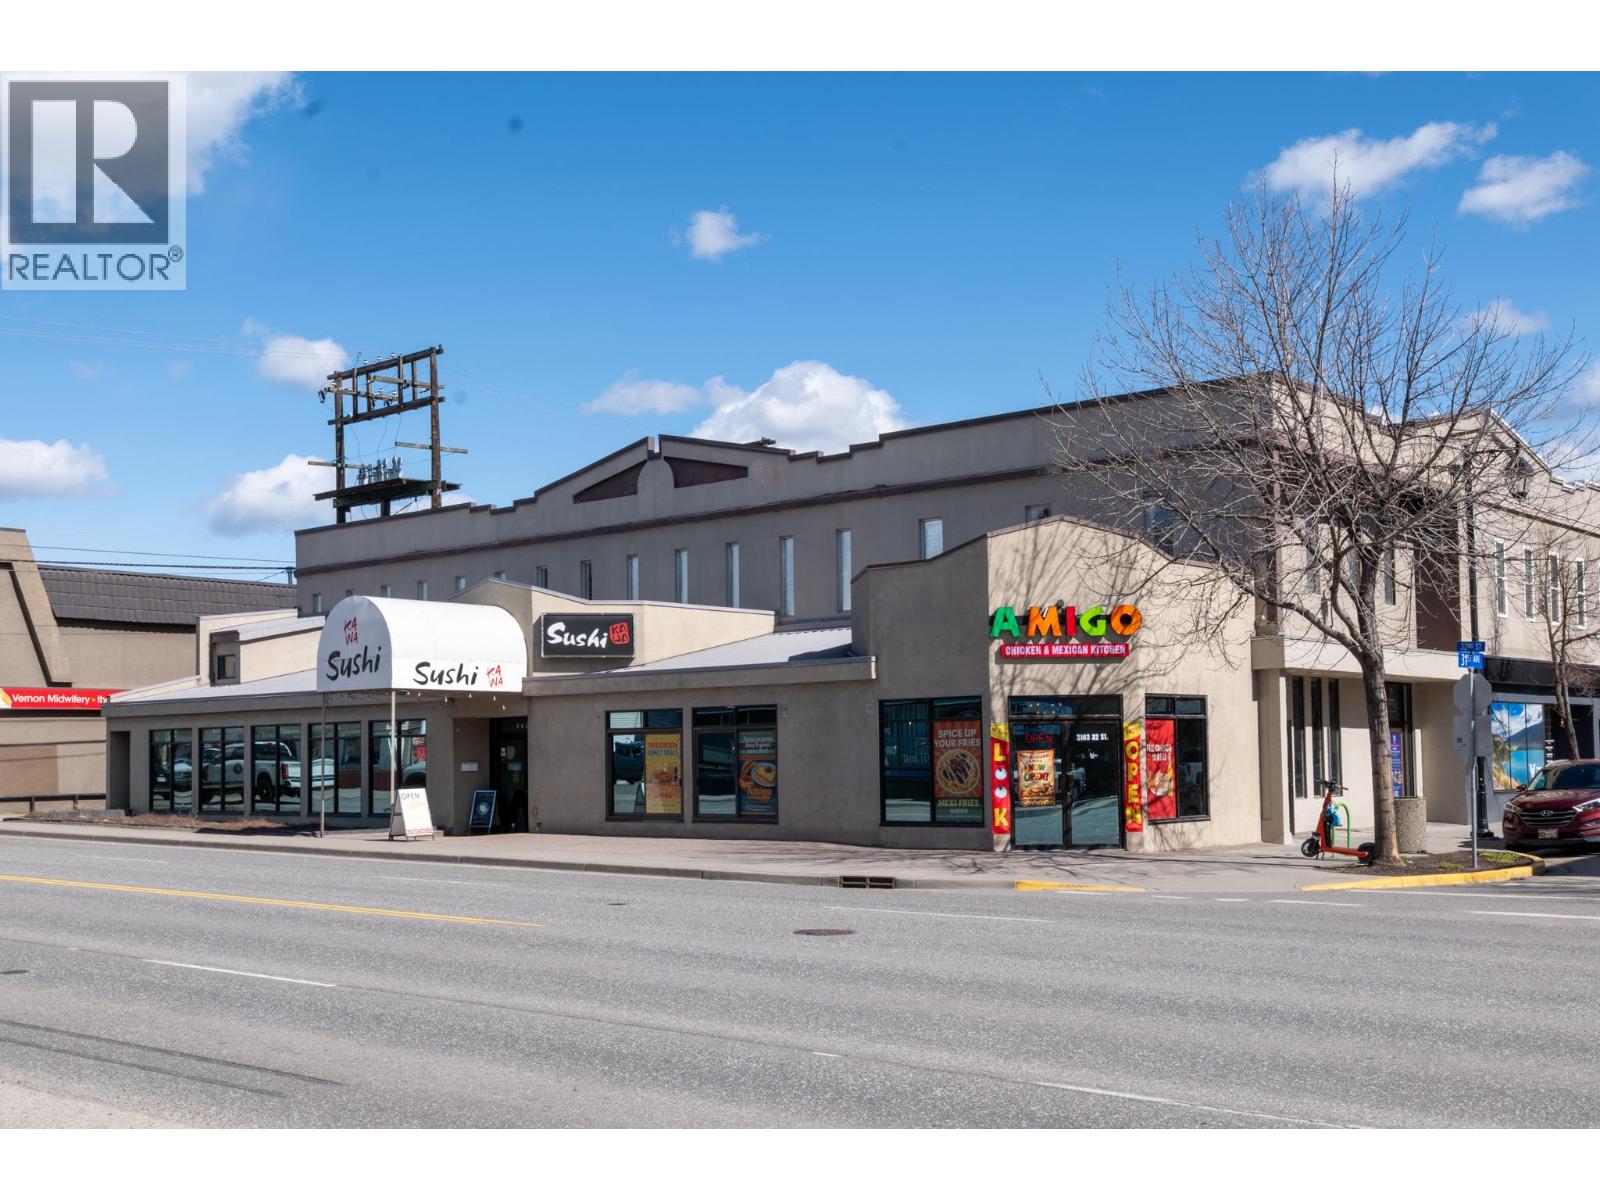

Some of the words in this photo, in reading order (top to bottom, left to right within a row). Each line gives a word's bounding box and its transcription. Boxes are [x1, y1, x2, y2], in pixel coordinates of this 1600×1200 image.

[990, 604, 1143, 637] AMIGO
[546, 621, 609, 649] Sushi
[1005, 645, 1041, 656] CHICKEN
[1043, 645, 1049, 655] &
[1052, 644, 1088, 655] MEXICAN
[1090, 643, 1125, 654] KITCHEN
[326, 645, 382, 681] Sushi
[413, 661, 479, 685] Sushi
[12, 693, 45, 703] Vernon
[47, 694, 90, 705] Midwifery
[937, 730, 963, 738] SPICE
[964, 729, 977, 737] UP
[934, 739, 957, 748] YOUR
[958, 738, 981, 747] FRIES
[1028, 763, 1046, 772] NOW
[1126, 741, 1142, 825] OPEN
[938, 799, 957, 807] MEXI
[958, 799, 980, 807] FRIES
